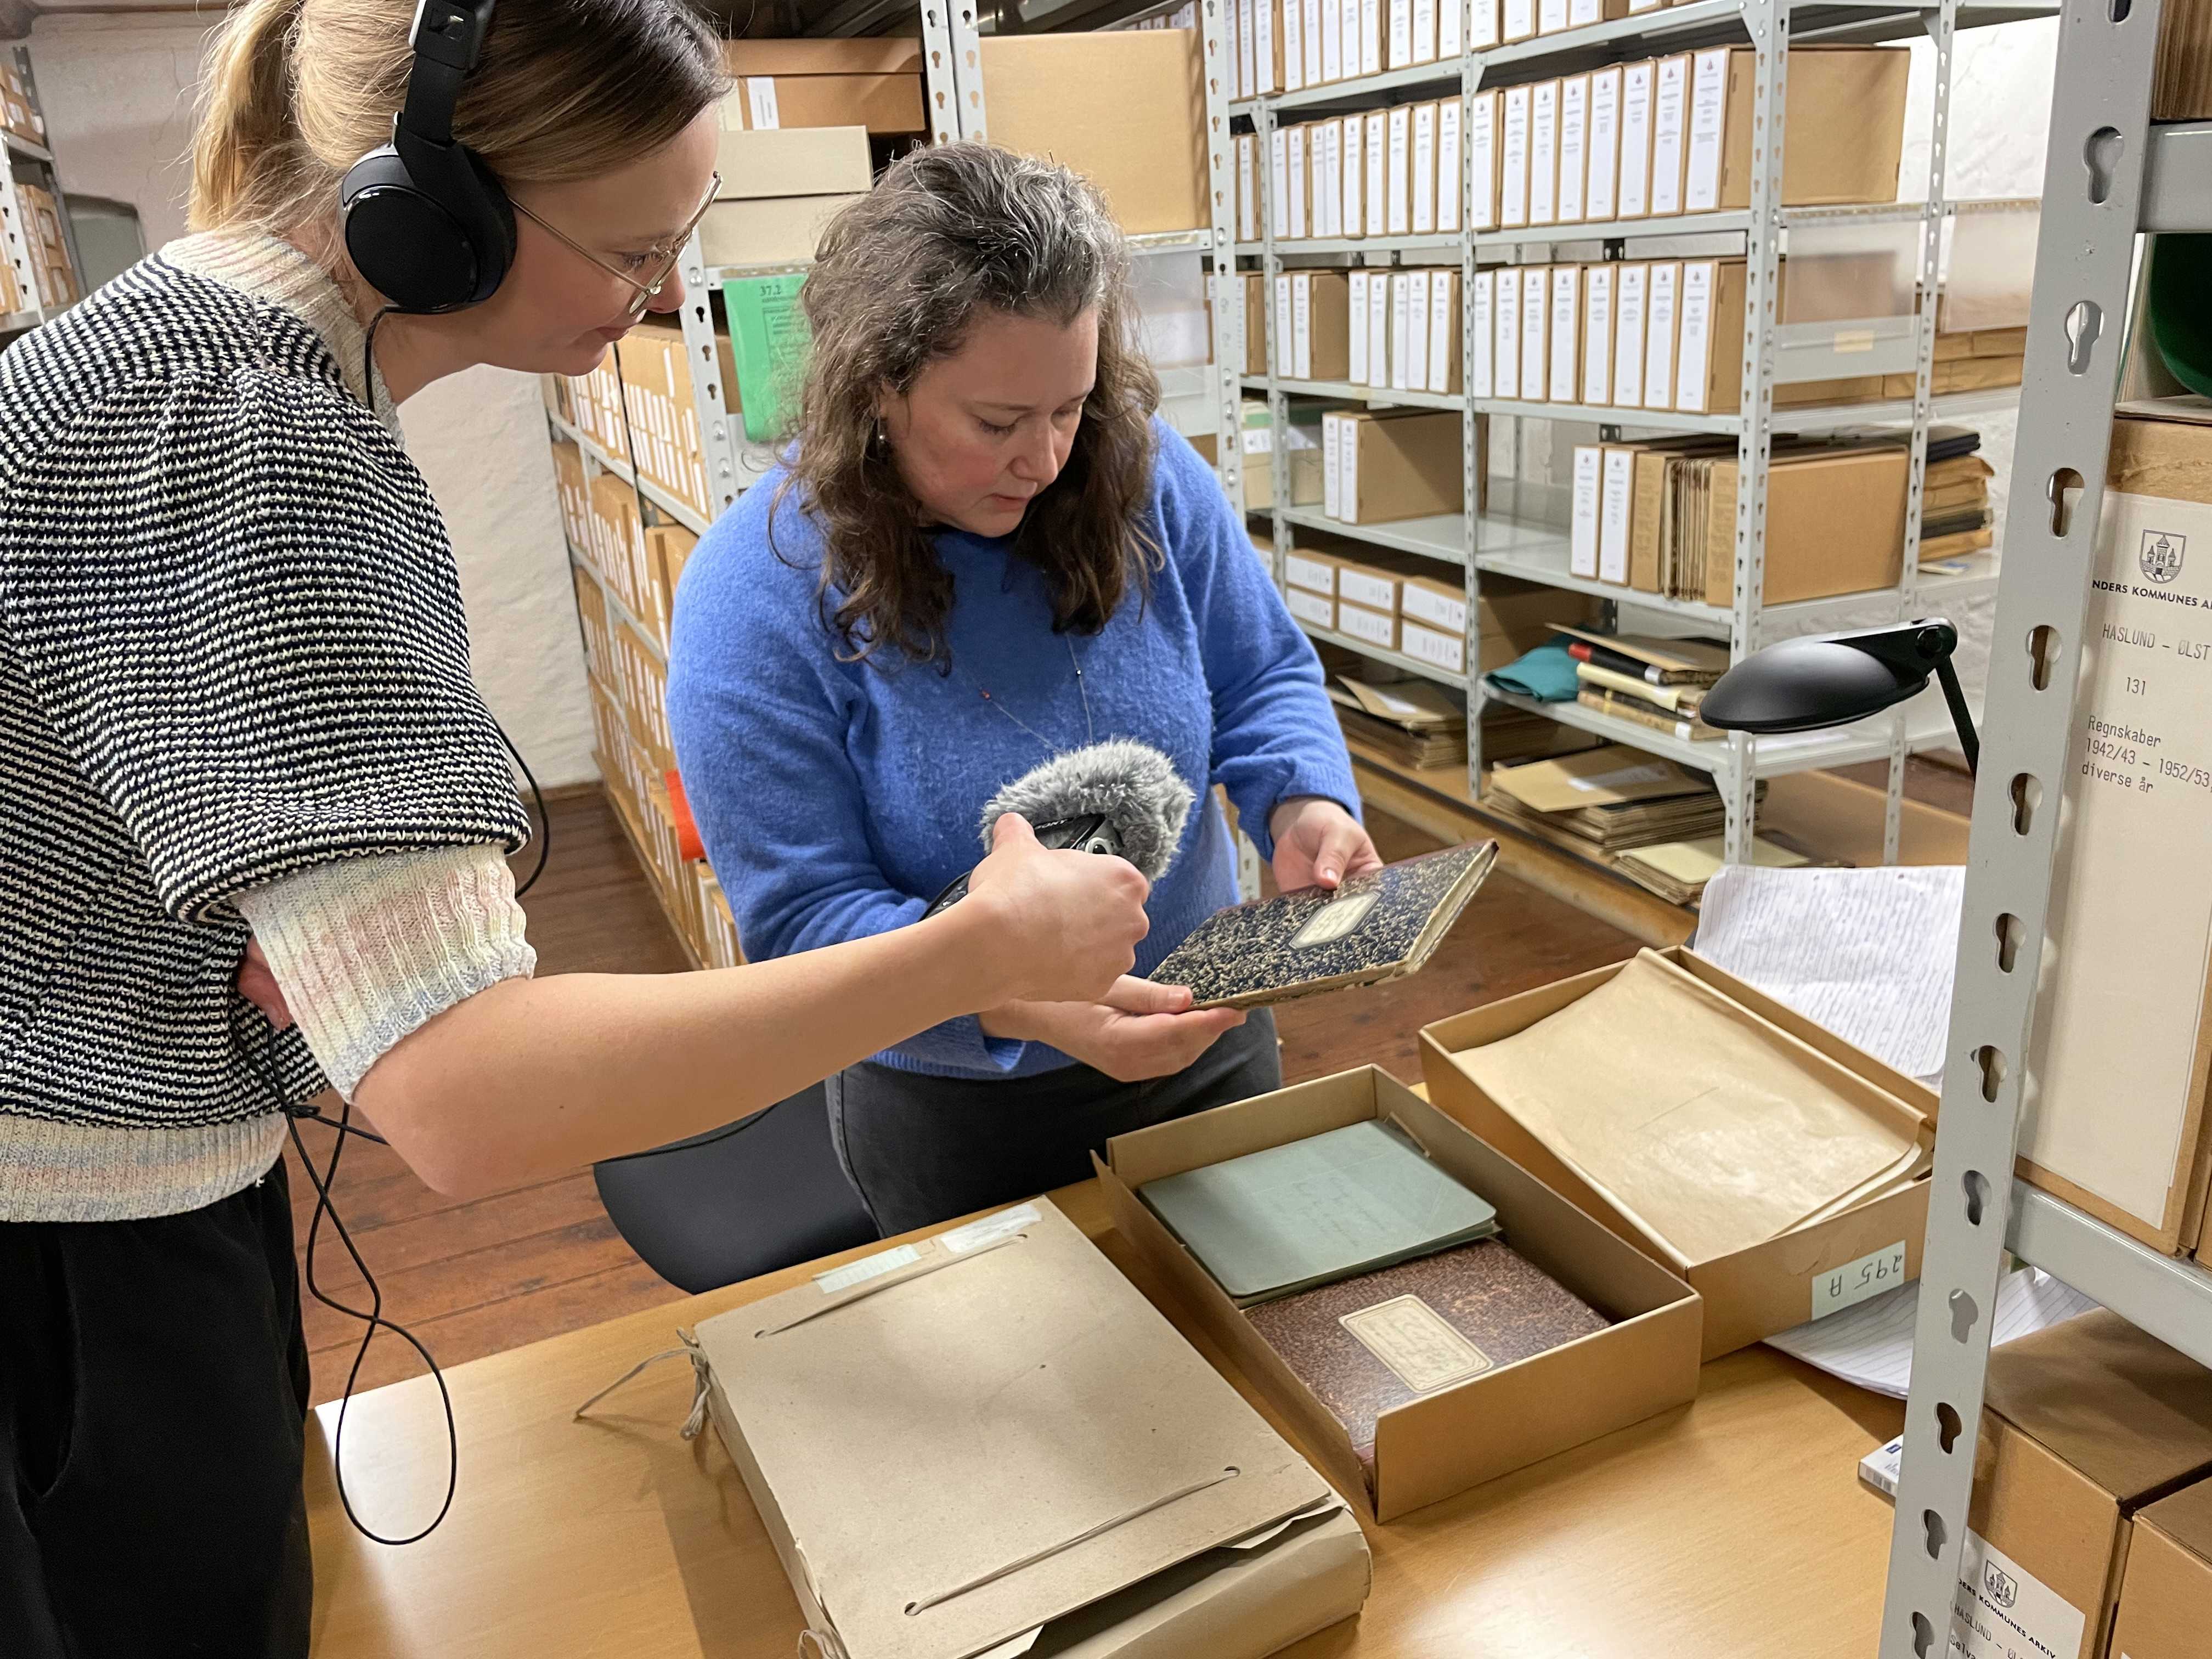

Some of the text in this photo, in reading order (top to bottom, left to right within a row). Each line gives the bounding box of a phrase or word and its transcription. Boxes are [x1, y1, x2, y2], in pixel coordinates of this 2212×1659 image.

[2132, 586, 2198, 607] KOMMUNES
[2201, 600, 2212, 610] A
[2102, 623, 2155, 648] HASLUND
[2126, 677, 2146, 696] 131
[2087, 715, 2161, 747] Regnskaber
[2086, 738, 2136, 765] 1942/43
[2082, 761, 2153, 793] diverse år
[1830, 1273, 1842, 1297] A
[1954, 1604, 1991, 1641] HASLUND
[1979, 1594, 2027, 1637] KOMMUNES
[2028, 1637, 2056, 1659] ARKIV
